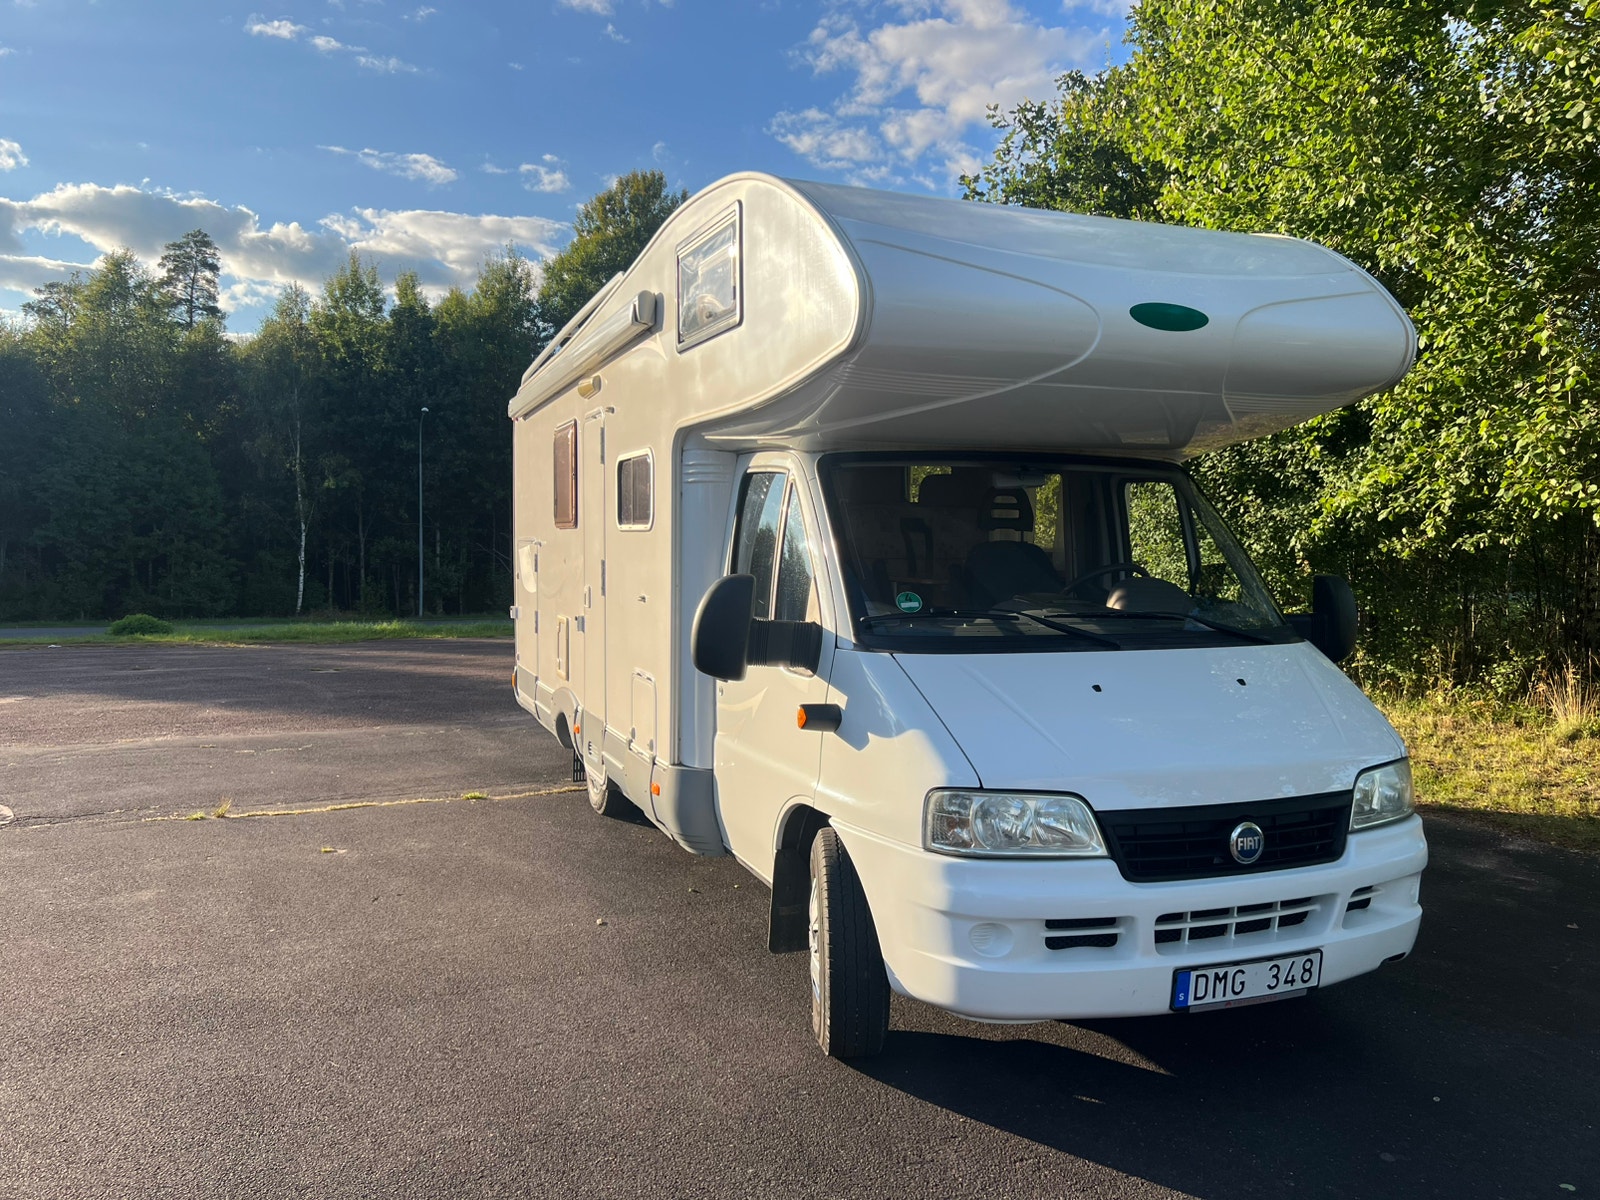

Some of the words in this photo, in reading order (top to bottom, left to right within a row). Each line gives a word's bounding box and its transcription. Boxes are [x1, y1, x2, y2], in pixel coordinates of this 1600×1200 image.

[1237, 836, 1259, 850] FIAT
[1193, 969, 1245, 1001] DMG
[1267, 958, 1313, 990] 348
[1178, 992, 1184, 1001] S
